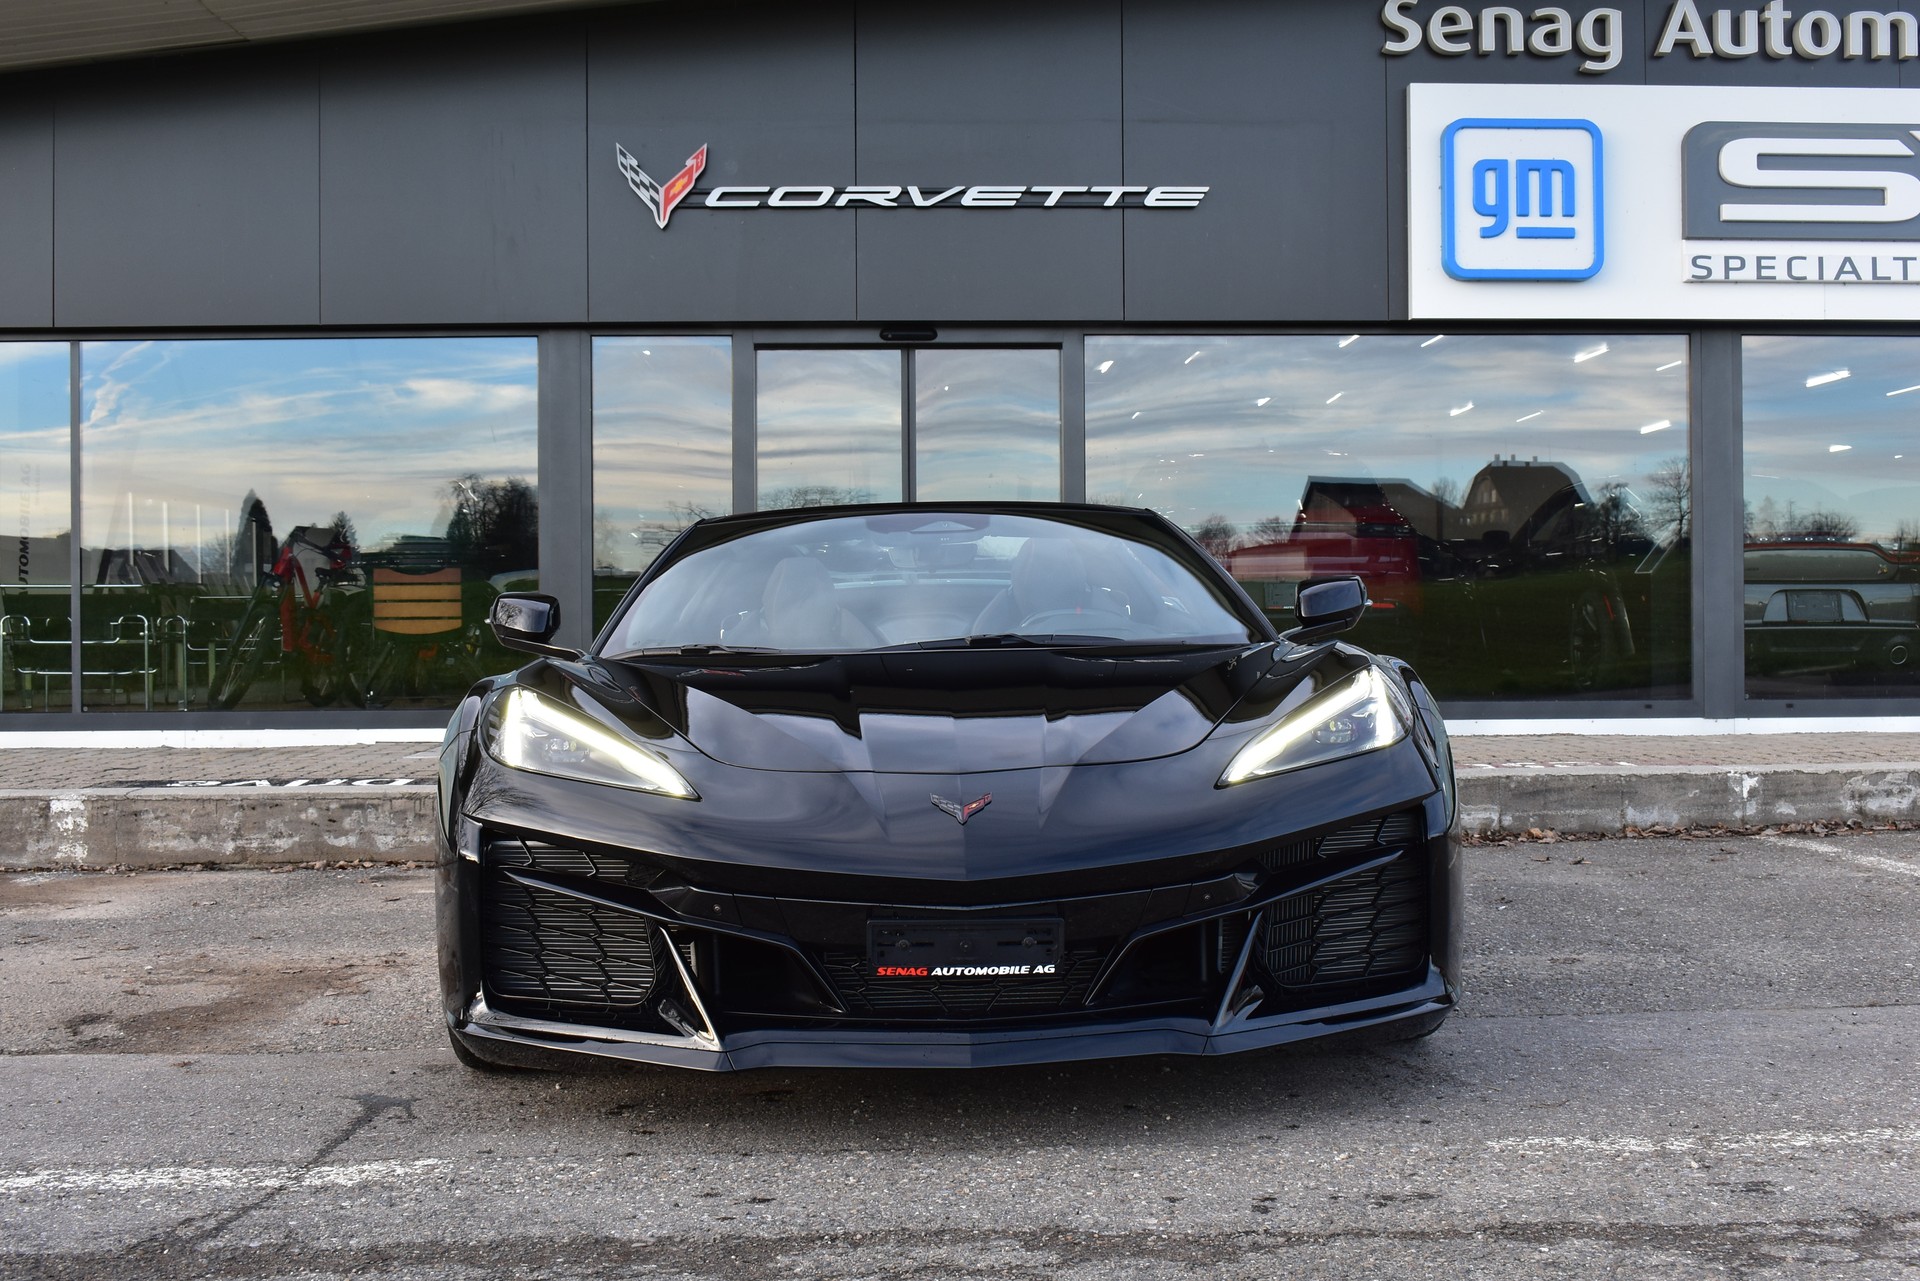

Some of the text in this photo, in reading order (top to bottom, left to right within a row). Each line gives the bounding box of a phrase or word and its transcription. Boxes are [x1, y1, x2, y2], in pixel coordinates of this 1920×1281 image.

[1381, 0, 1919, 72] Senag Autom
[704, 186, 1211, 208] CORVETTE
[1472, 158, 1576, 240] gm
[1718, 130, 1920, 223] S
[1690, 254, 1918, 281] SPECIALT
[876, 964, 1056, 976] SENAG AUTOMOBILE AG
